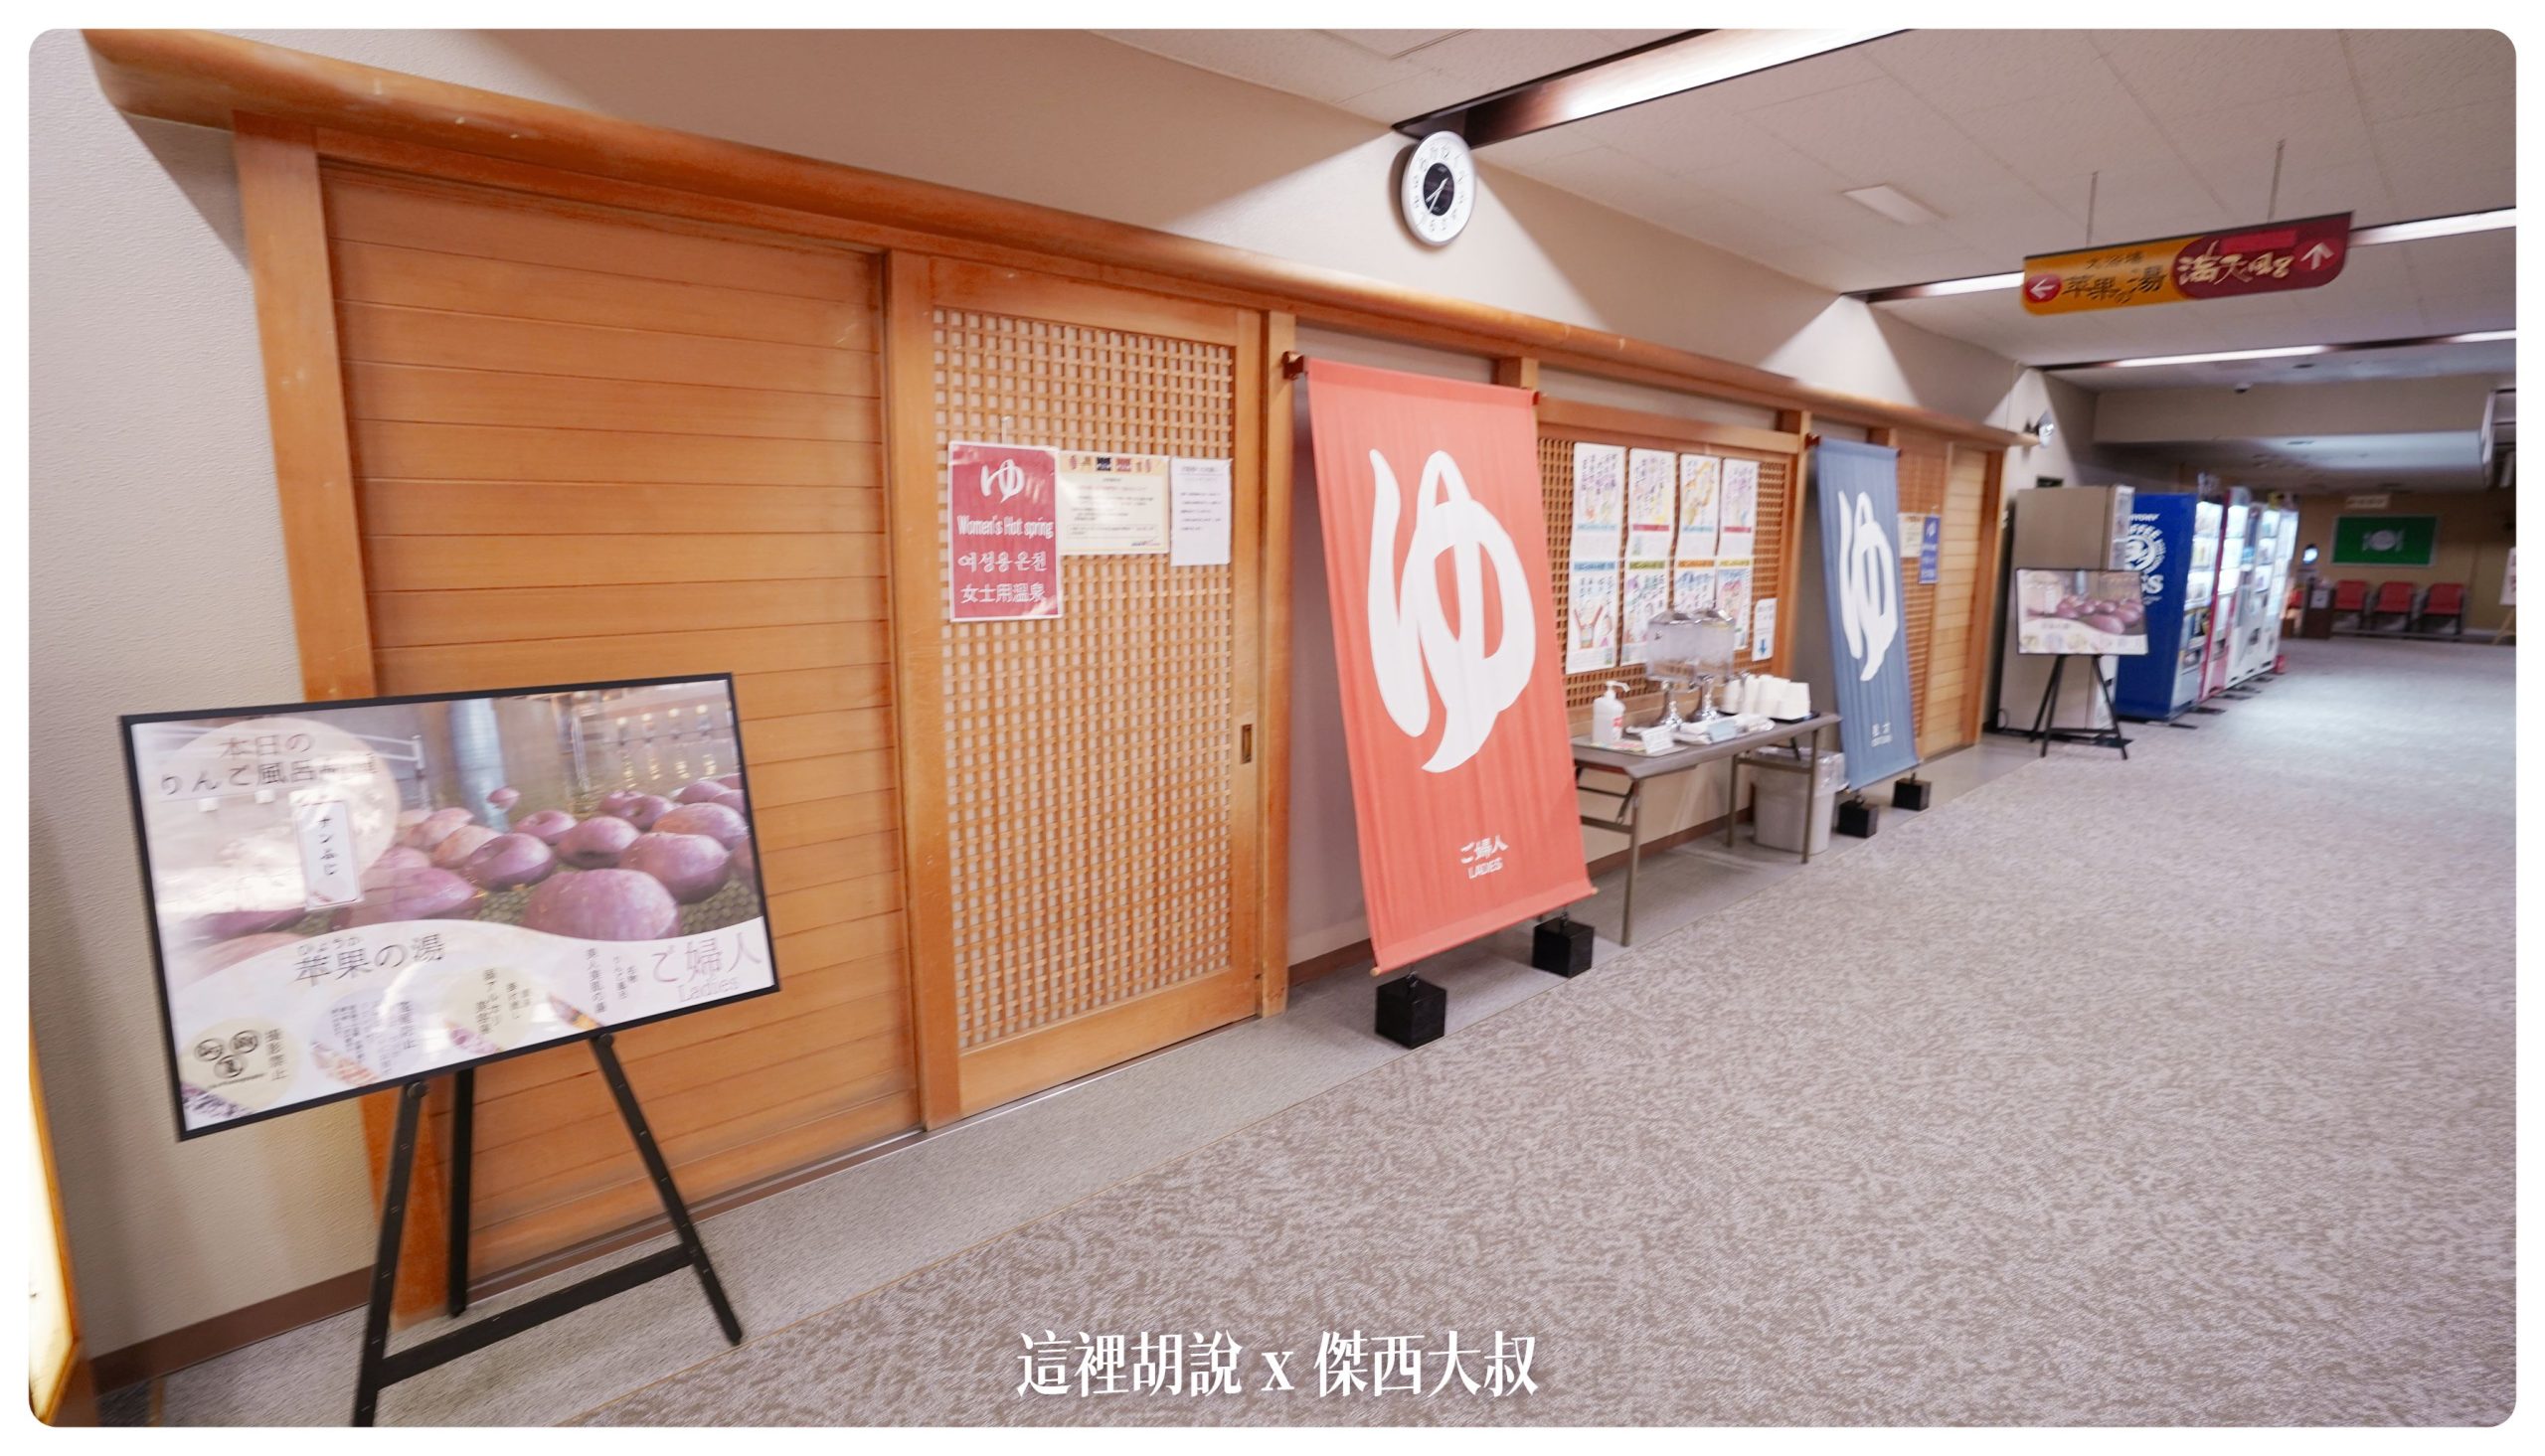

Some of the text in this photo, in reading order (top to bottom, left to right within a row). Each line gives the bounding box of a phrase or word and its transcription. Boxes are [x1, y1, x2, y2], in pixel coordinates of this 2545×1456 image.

[980, 458, 1025, 503] ゆ
[956, 514, 1002, 536] Women's
[1004, 516, 1022, 536] Hot
[1024, 517, 1054, 540] spring
[957, 551, 1047, 573] 여성용 온천
[1838, 491, 1898, 682] ゆ
[1368, 449, 1536, 772] ゆ
[221, 732, 315, 759] 本日の
[1460, 834, 1509, 865] ご婦人
[651, 932, 763, 984] ご婦人
[678, 976, 741, 1002] Ladies
